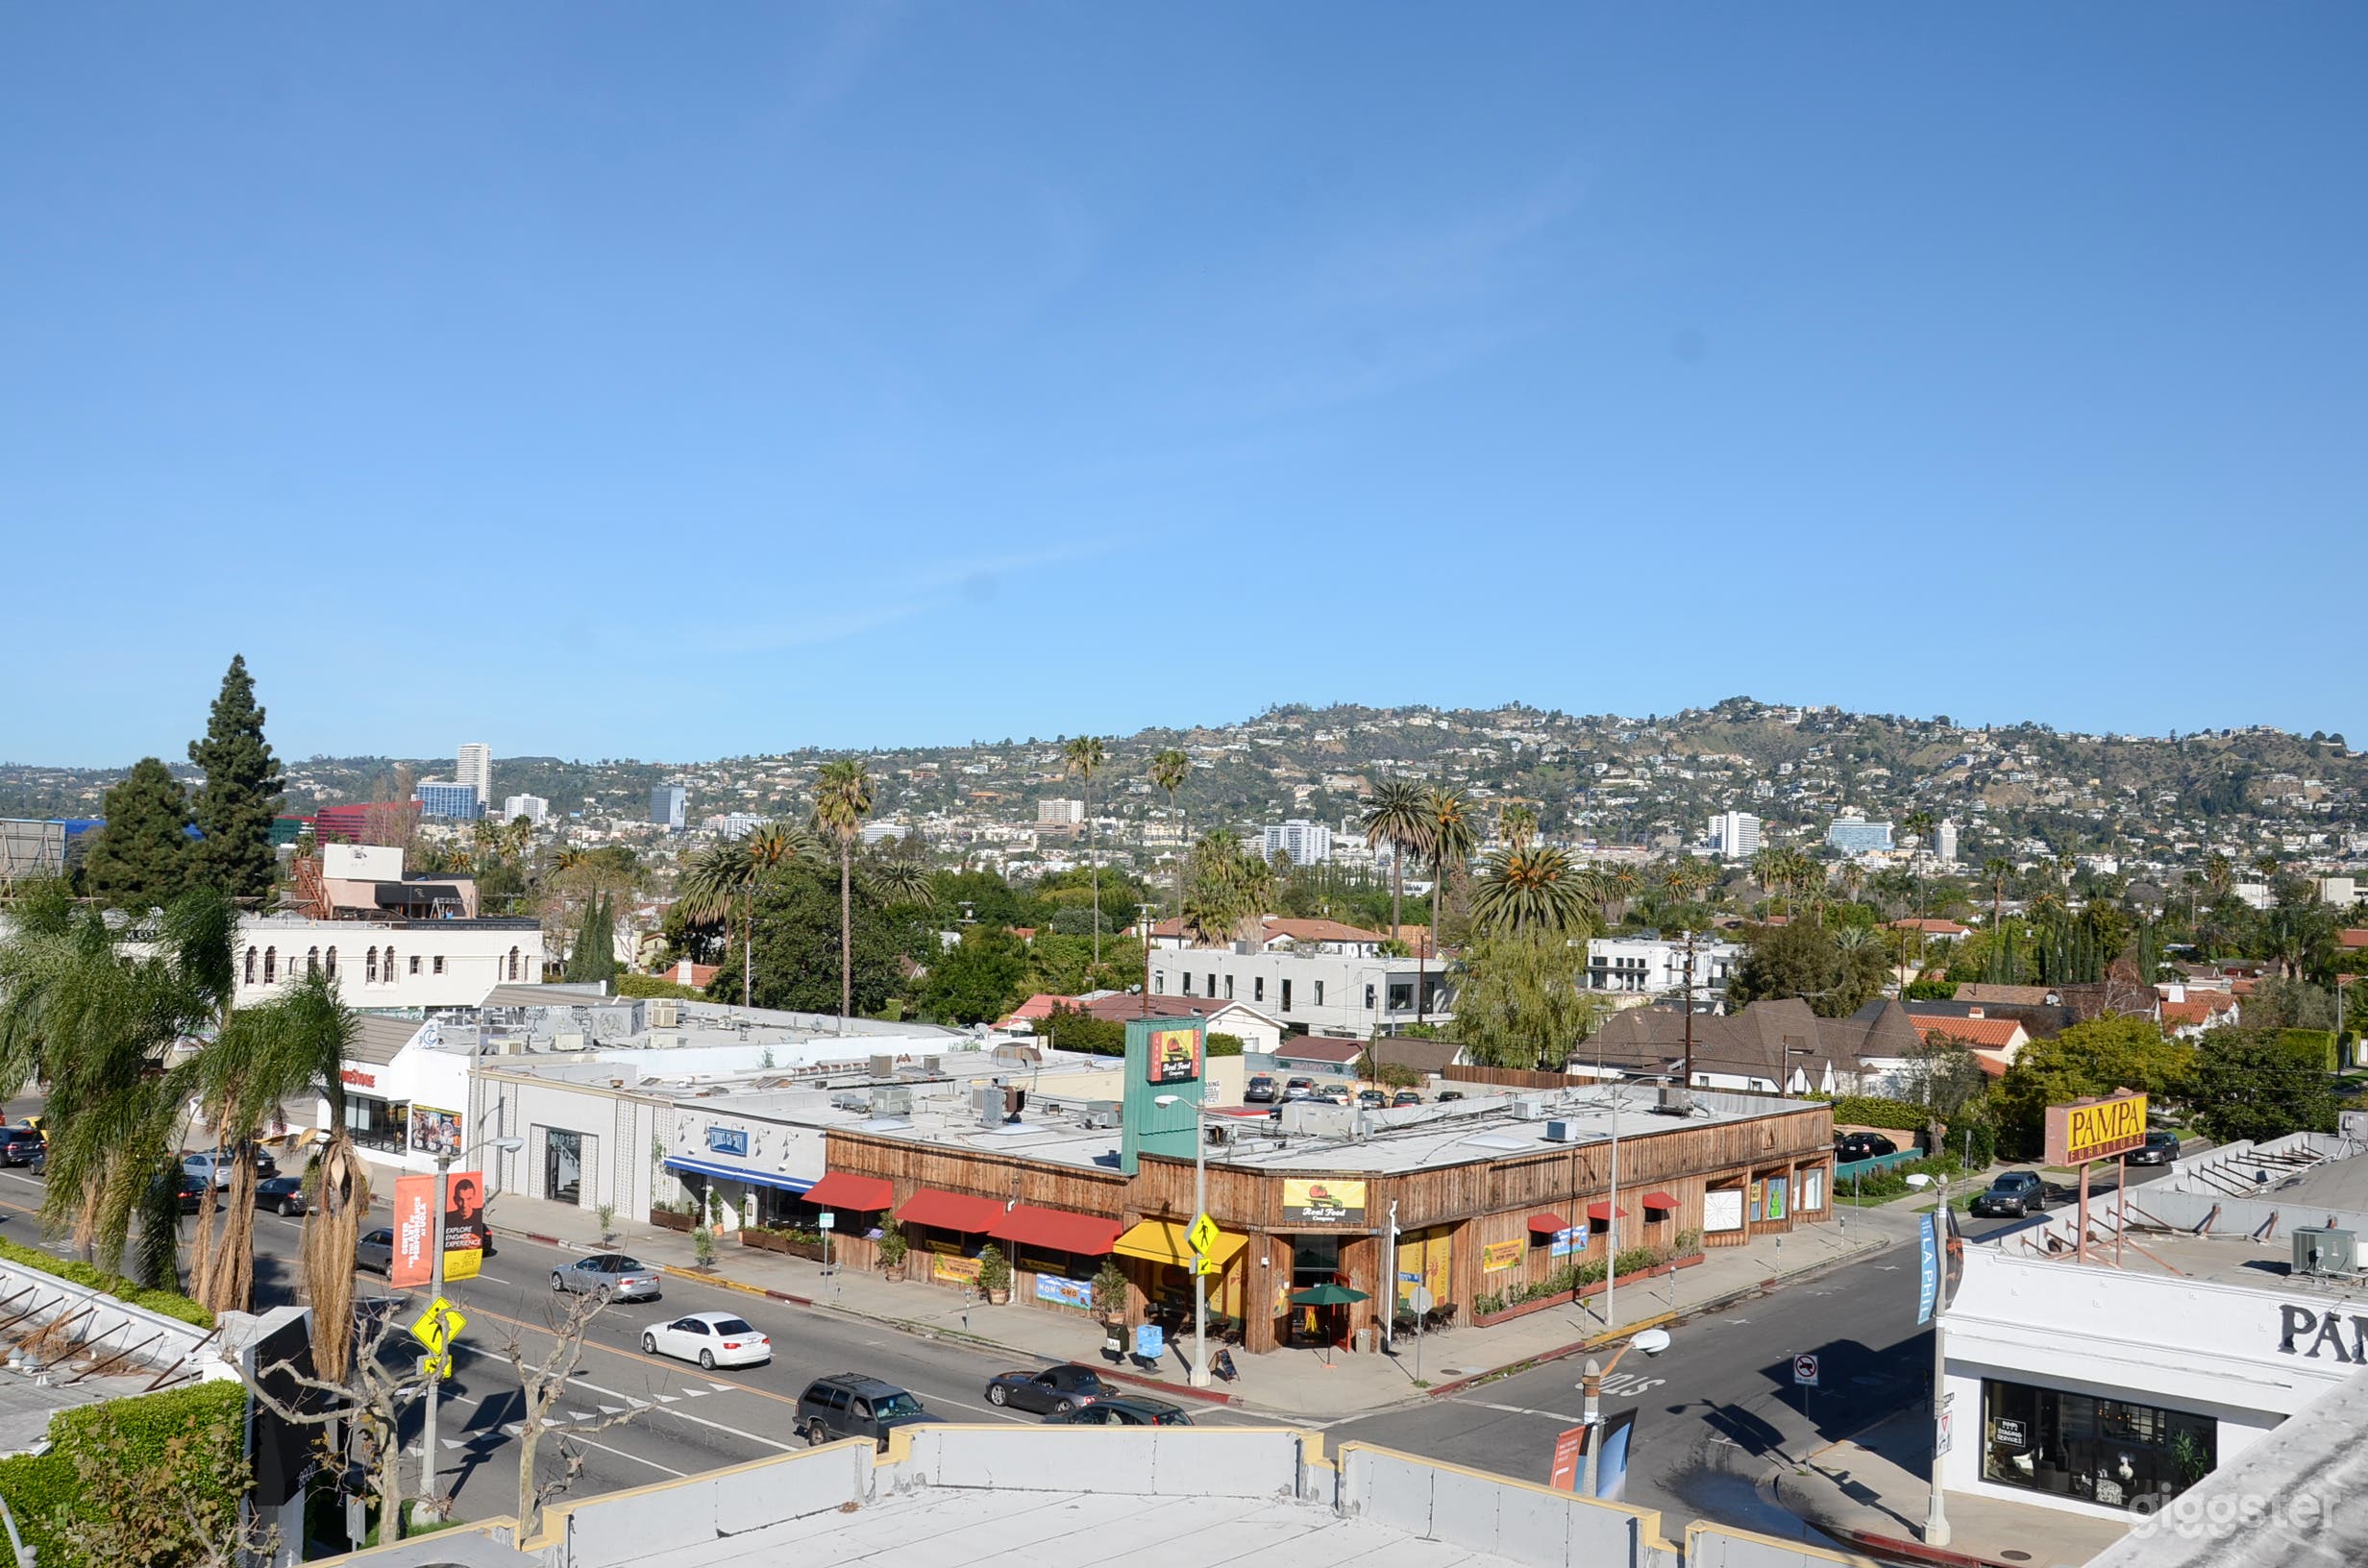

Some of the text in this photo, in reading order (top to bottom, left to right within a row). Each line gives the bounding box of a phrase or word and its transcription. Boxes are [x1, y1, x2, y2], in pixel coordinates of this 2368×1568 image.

[1177, 1061, 1191, 1070] Food
[2072, 1099, 2140, 1147] PAMPA
[2070, 1134, 2141, 1162] FURNITURE
[1302, 1207, 1346, 1217] Real Food
[445, 1226, 473, 1235] EXPLORE
[445, 1233, 472, 1241] ENGAGE
[445, 1238, 481, 1248] EXPERIENCE
[1922, 1237, 1933, 1264] LA
